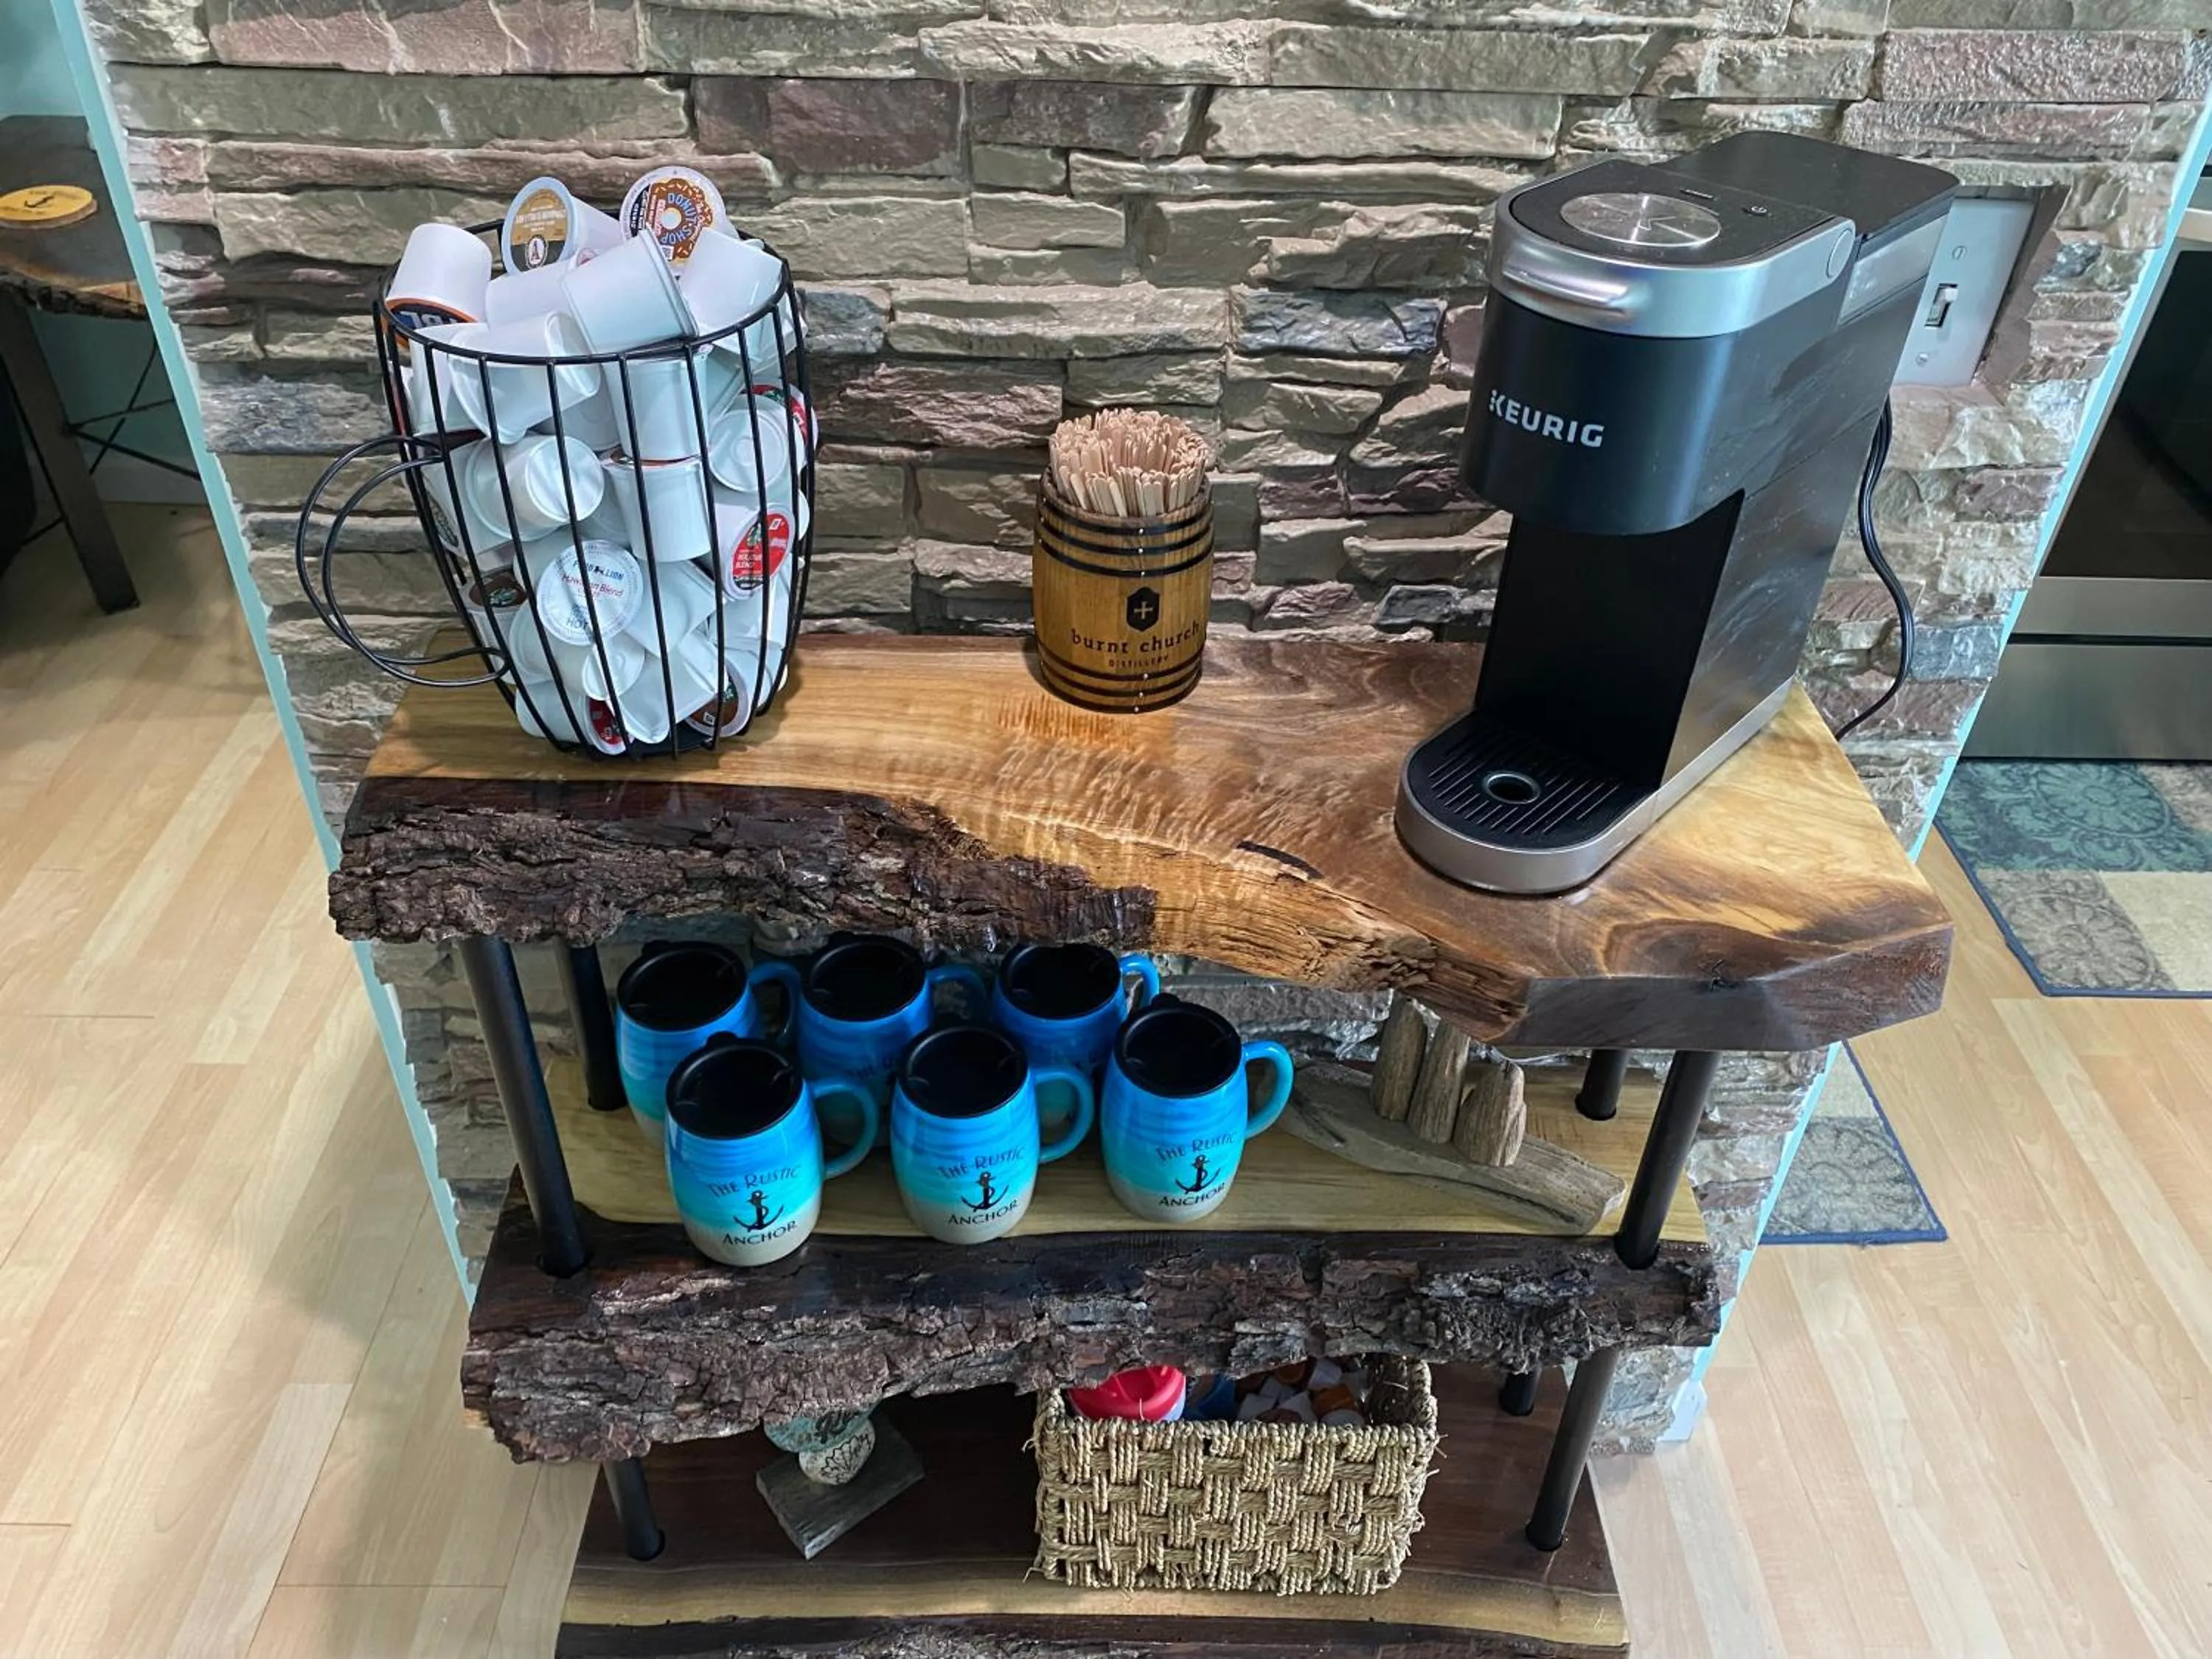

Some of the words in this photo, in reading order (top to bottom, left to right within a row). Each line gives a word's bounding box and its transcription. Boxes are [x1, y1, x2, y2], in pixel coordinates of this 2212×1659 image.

[667, 192, 699, 224] DONUT
[661, 223, 692, 245] SHOP
[1489, 389, 1605, 448] KEURIG
[1071, 627, 1130, 654] burnt
[1139, 620, 1200, 653] church
[1155, 1144, 1186, 1161] THE
[1192, 1132, 1238, 1152] RUSTIC
[937, 1163, 968, 1179] THE
[974, 1146, 1026, 1169] RUSTIC
[708, 1181, 740, 1198] THE
[744, 1164, 801, 1189] RUSTIC
[1158, 1181, 1225, 1207] ANCHOR
[947, 1199, 1020, 1225] ANCHOR
[723, 1220, 798, 1245] ANCHOR
